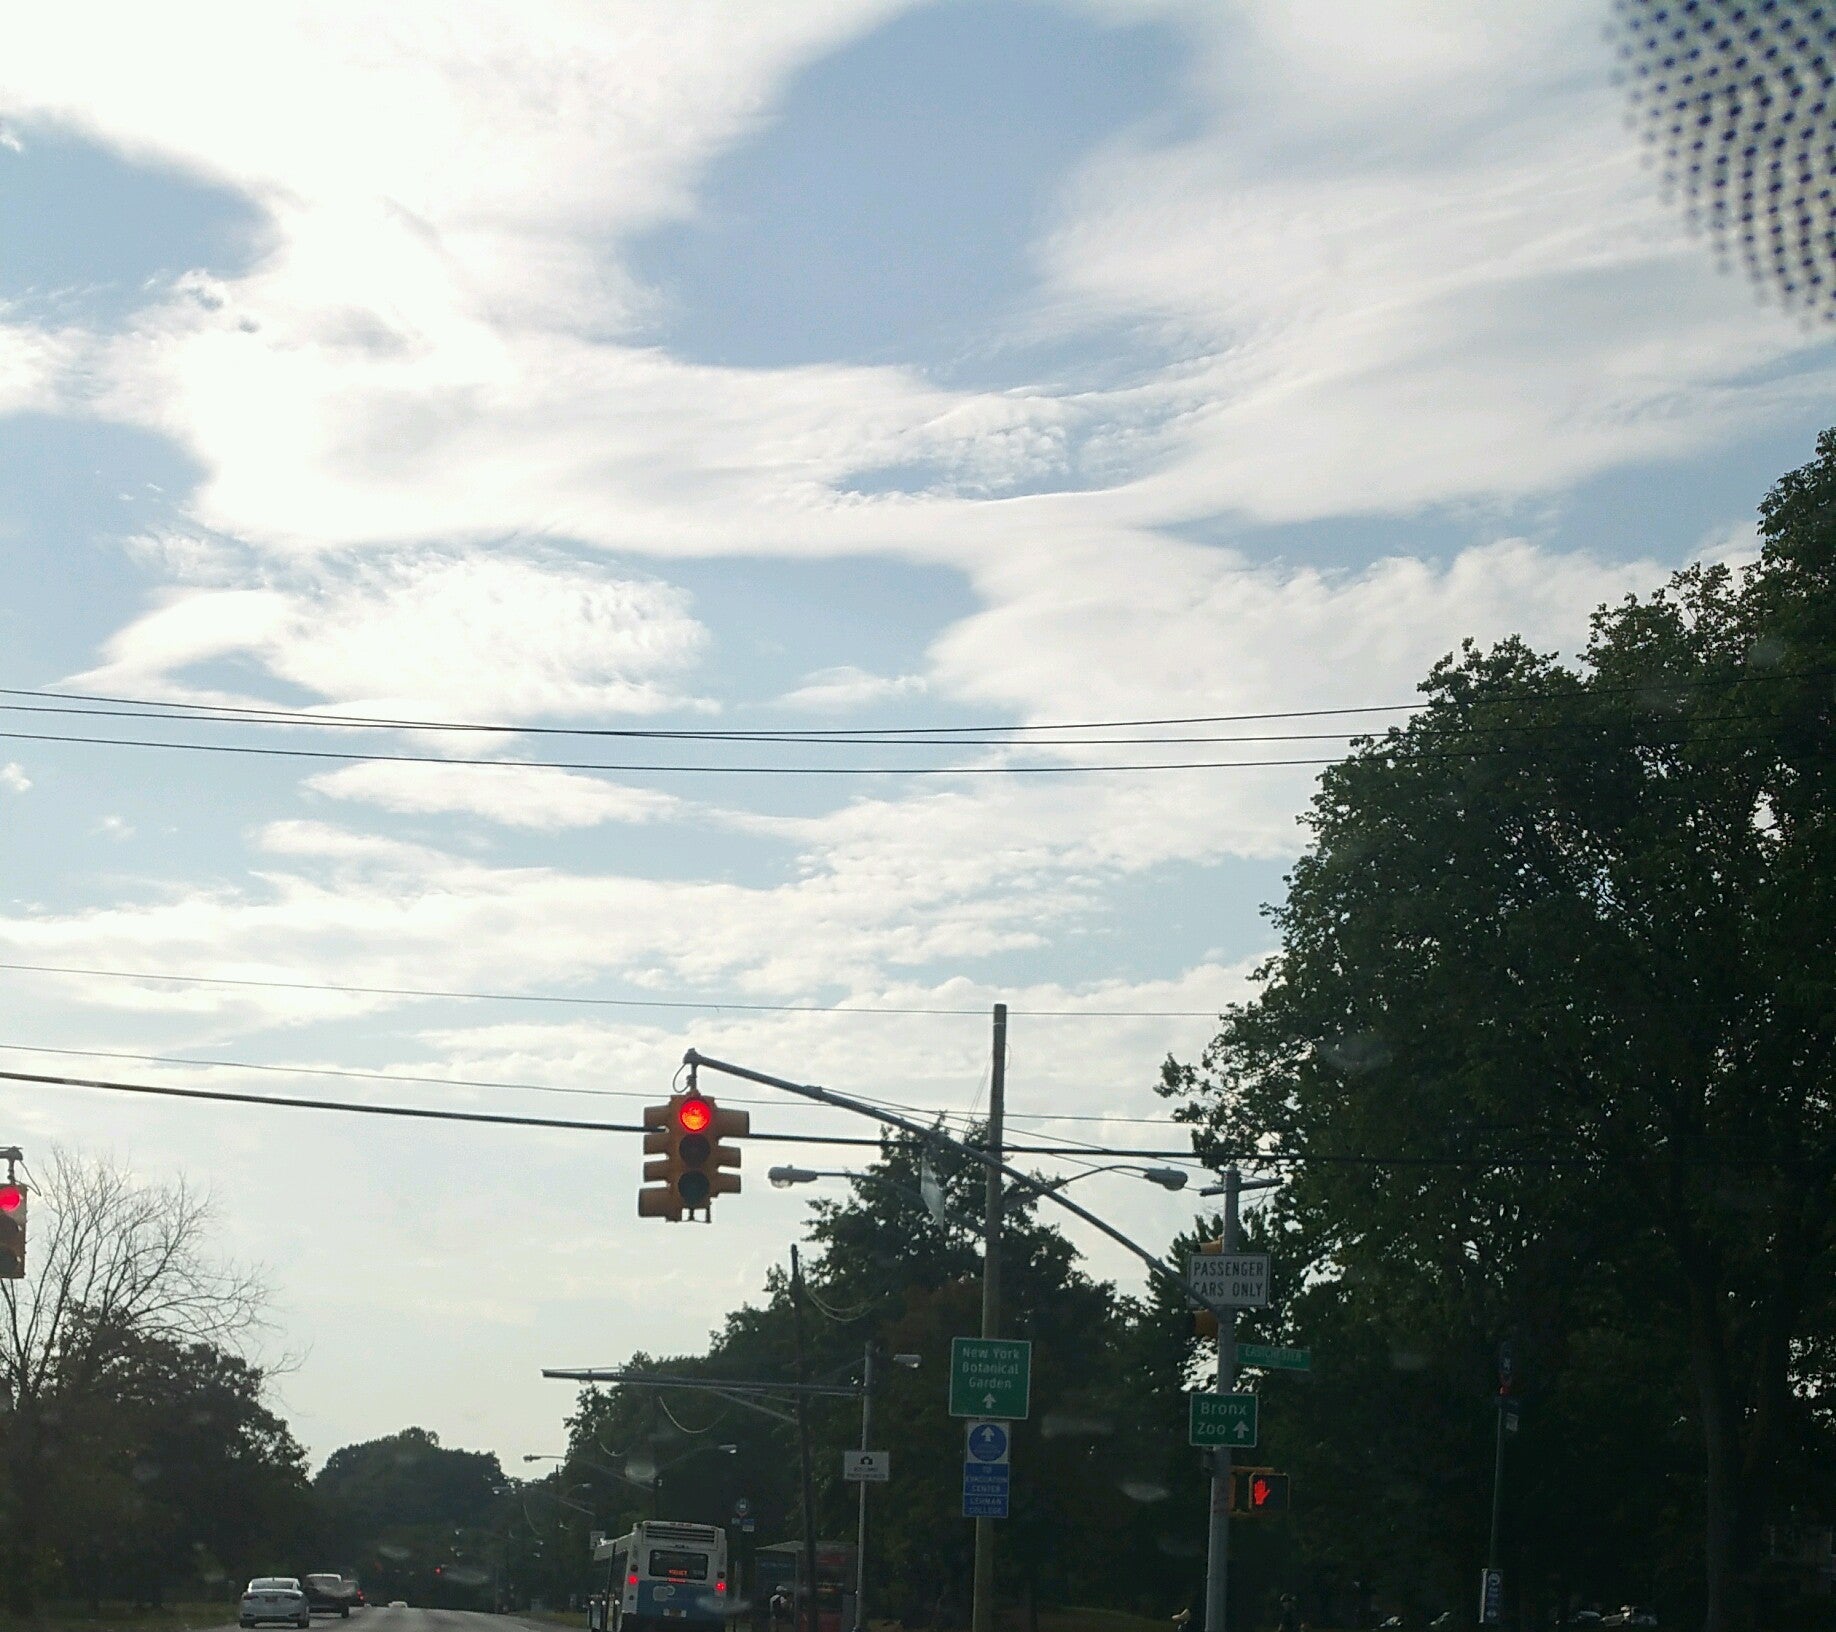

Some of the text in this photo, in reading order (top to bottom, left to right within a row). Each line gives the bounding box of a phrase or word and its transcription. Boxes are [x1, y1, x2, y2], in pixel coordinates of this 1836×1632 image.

[1194, 1261, 1264, 1278] PASSENGER
[1232, 1281, 1264, 1298] ONLY
[962, 1347, 1020, 1360] New York
[962, 1361, 1019, 1375] Botanical
[968, 1376, 1012, 1389] Garden
[1200, 1401, 1247, 1415] Bronx
[1197, 1421, 1226, 1436] Zoo
